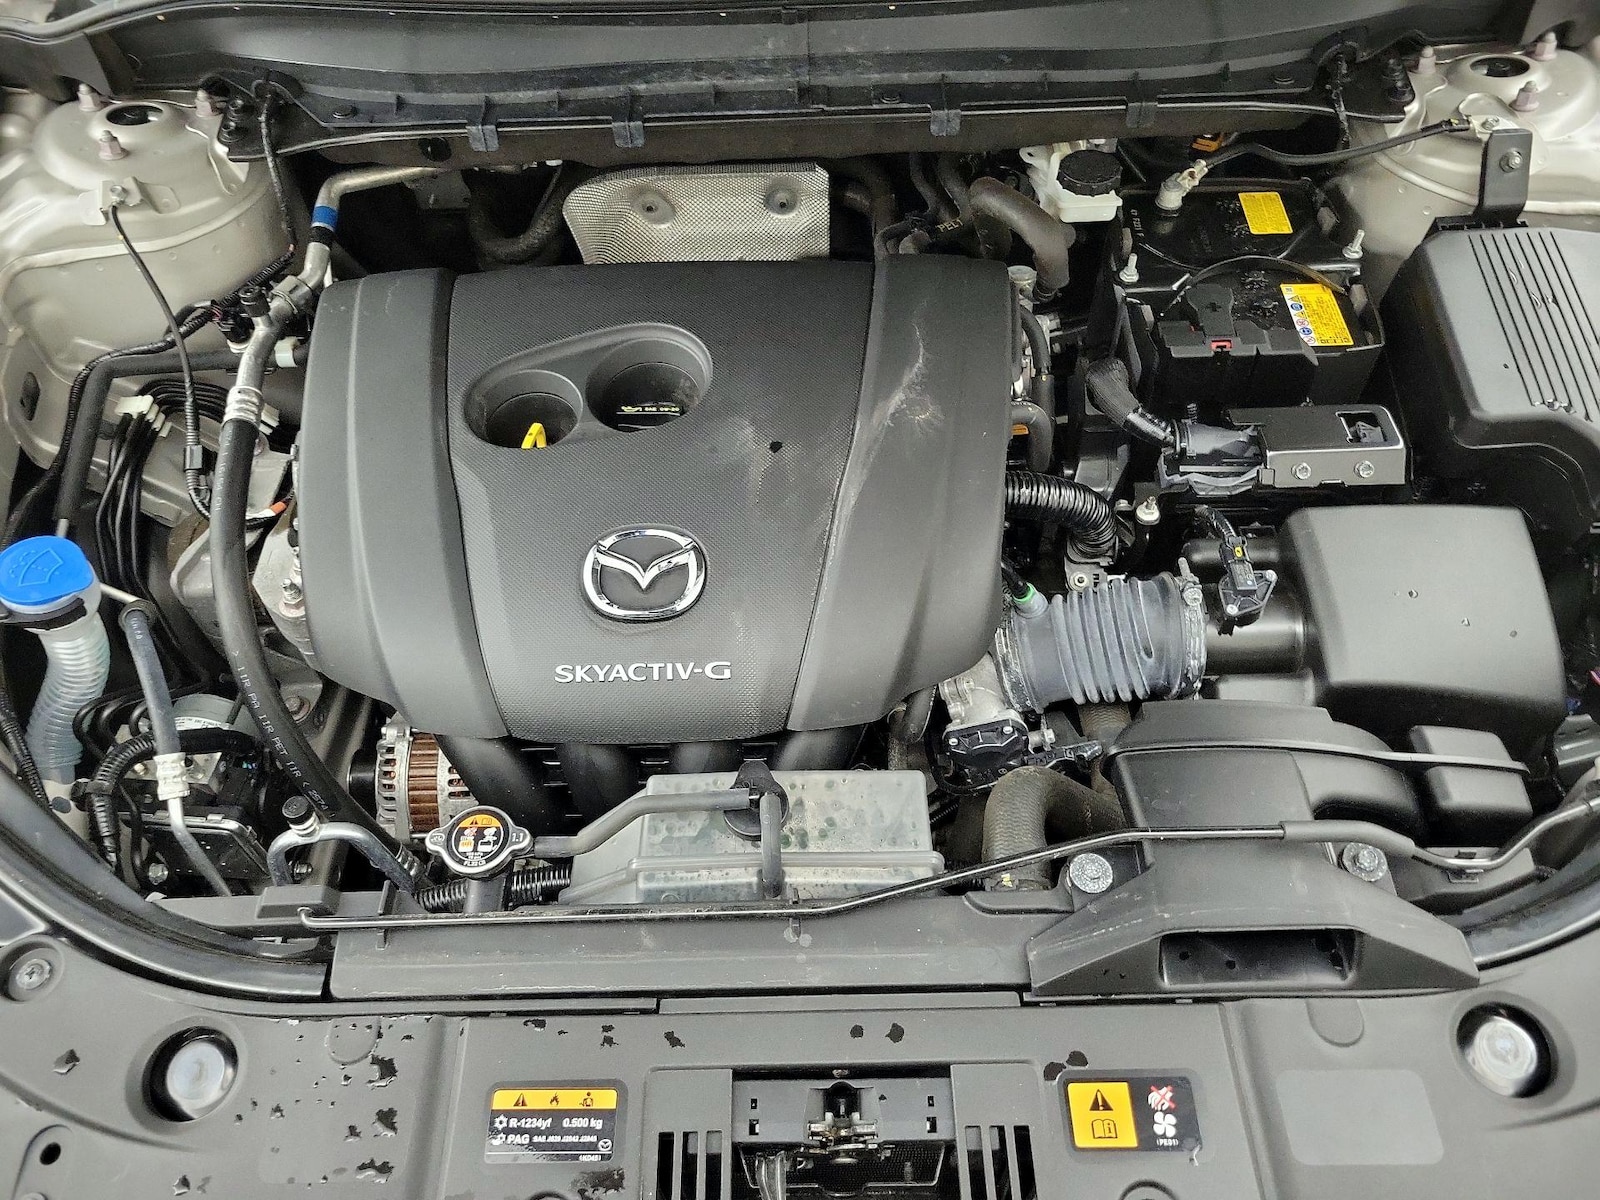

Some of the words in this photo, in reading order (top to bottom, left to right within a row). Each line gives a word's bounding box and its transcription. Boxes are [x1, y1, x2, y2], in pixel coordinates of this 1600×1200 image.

[554, 661, 732, 683] SKYACTIV-G
[272, 737, 288, 756] PET
[511, 832, 524, 842] 1.1
[508, 1117, 552, 1130] R-1234yf
[562, 1117, 589, 1128] 0.500
[589, 1117, 603, 1129] kg
[507, 1134, 530, 1144] PAG
